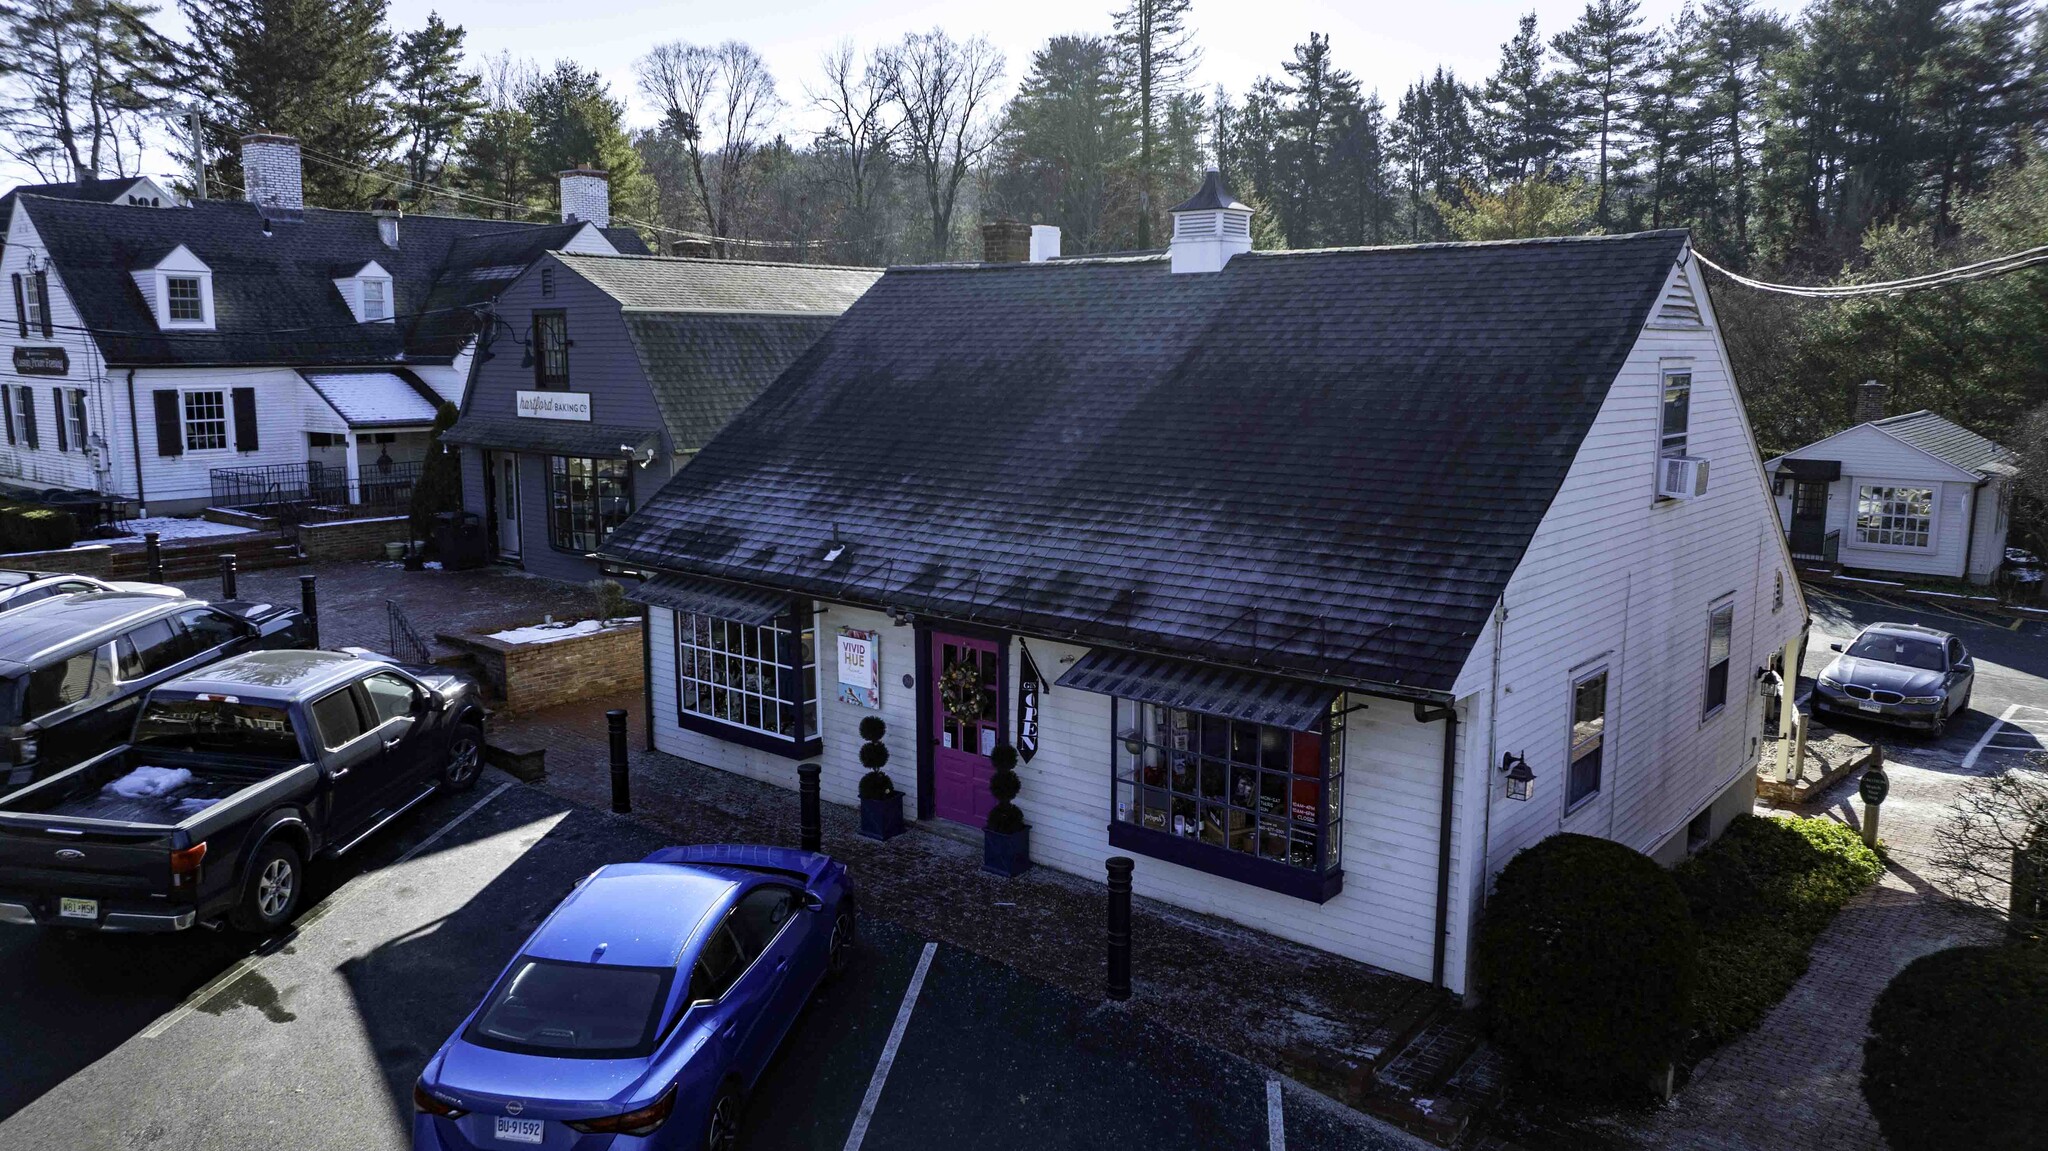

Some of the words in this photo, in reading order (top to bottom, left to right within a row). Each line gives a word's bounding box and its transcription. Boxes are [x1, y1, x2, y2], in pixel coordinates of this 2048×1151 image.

[519, 396, 553, 415] hartford
[554, 402, 579, 413] BAKING
[843, 641, 865, 654] VIVID
[844, 651, 864, 667] HUE
[1020, 692, 1038, 751] OPEN
